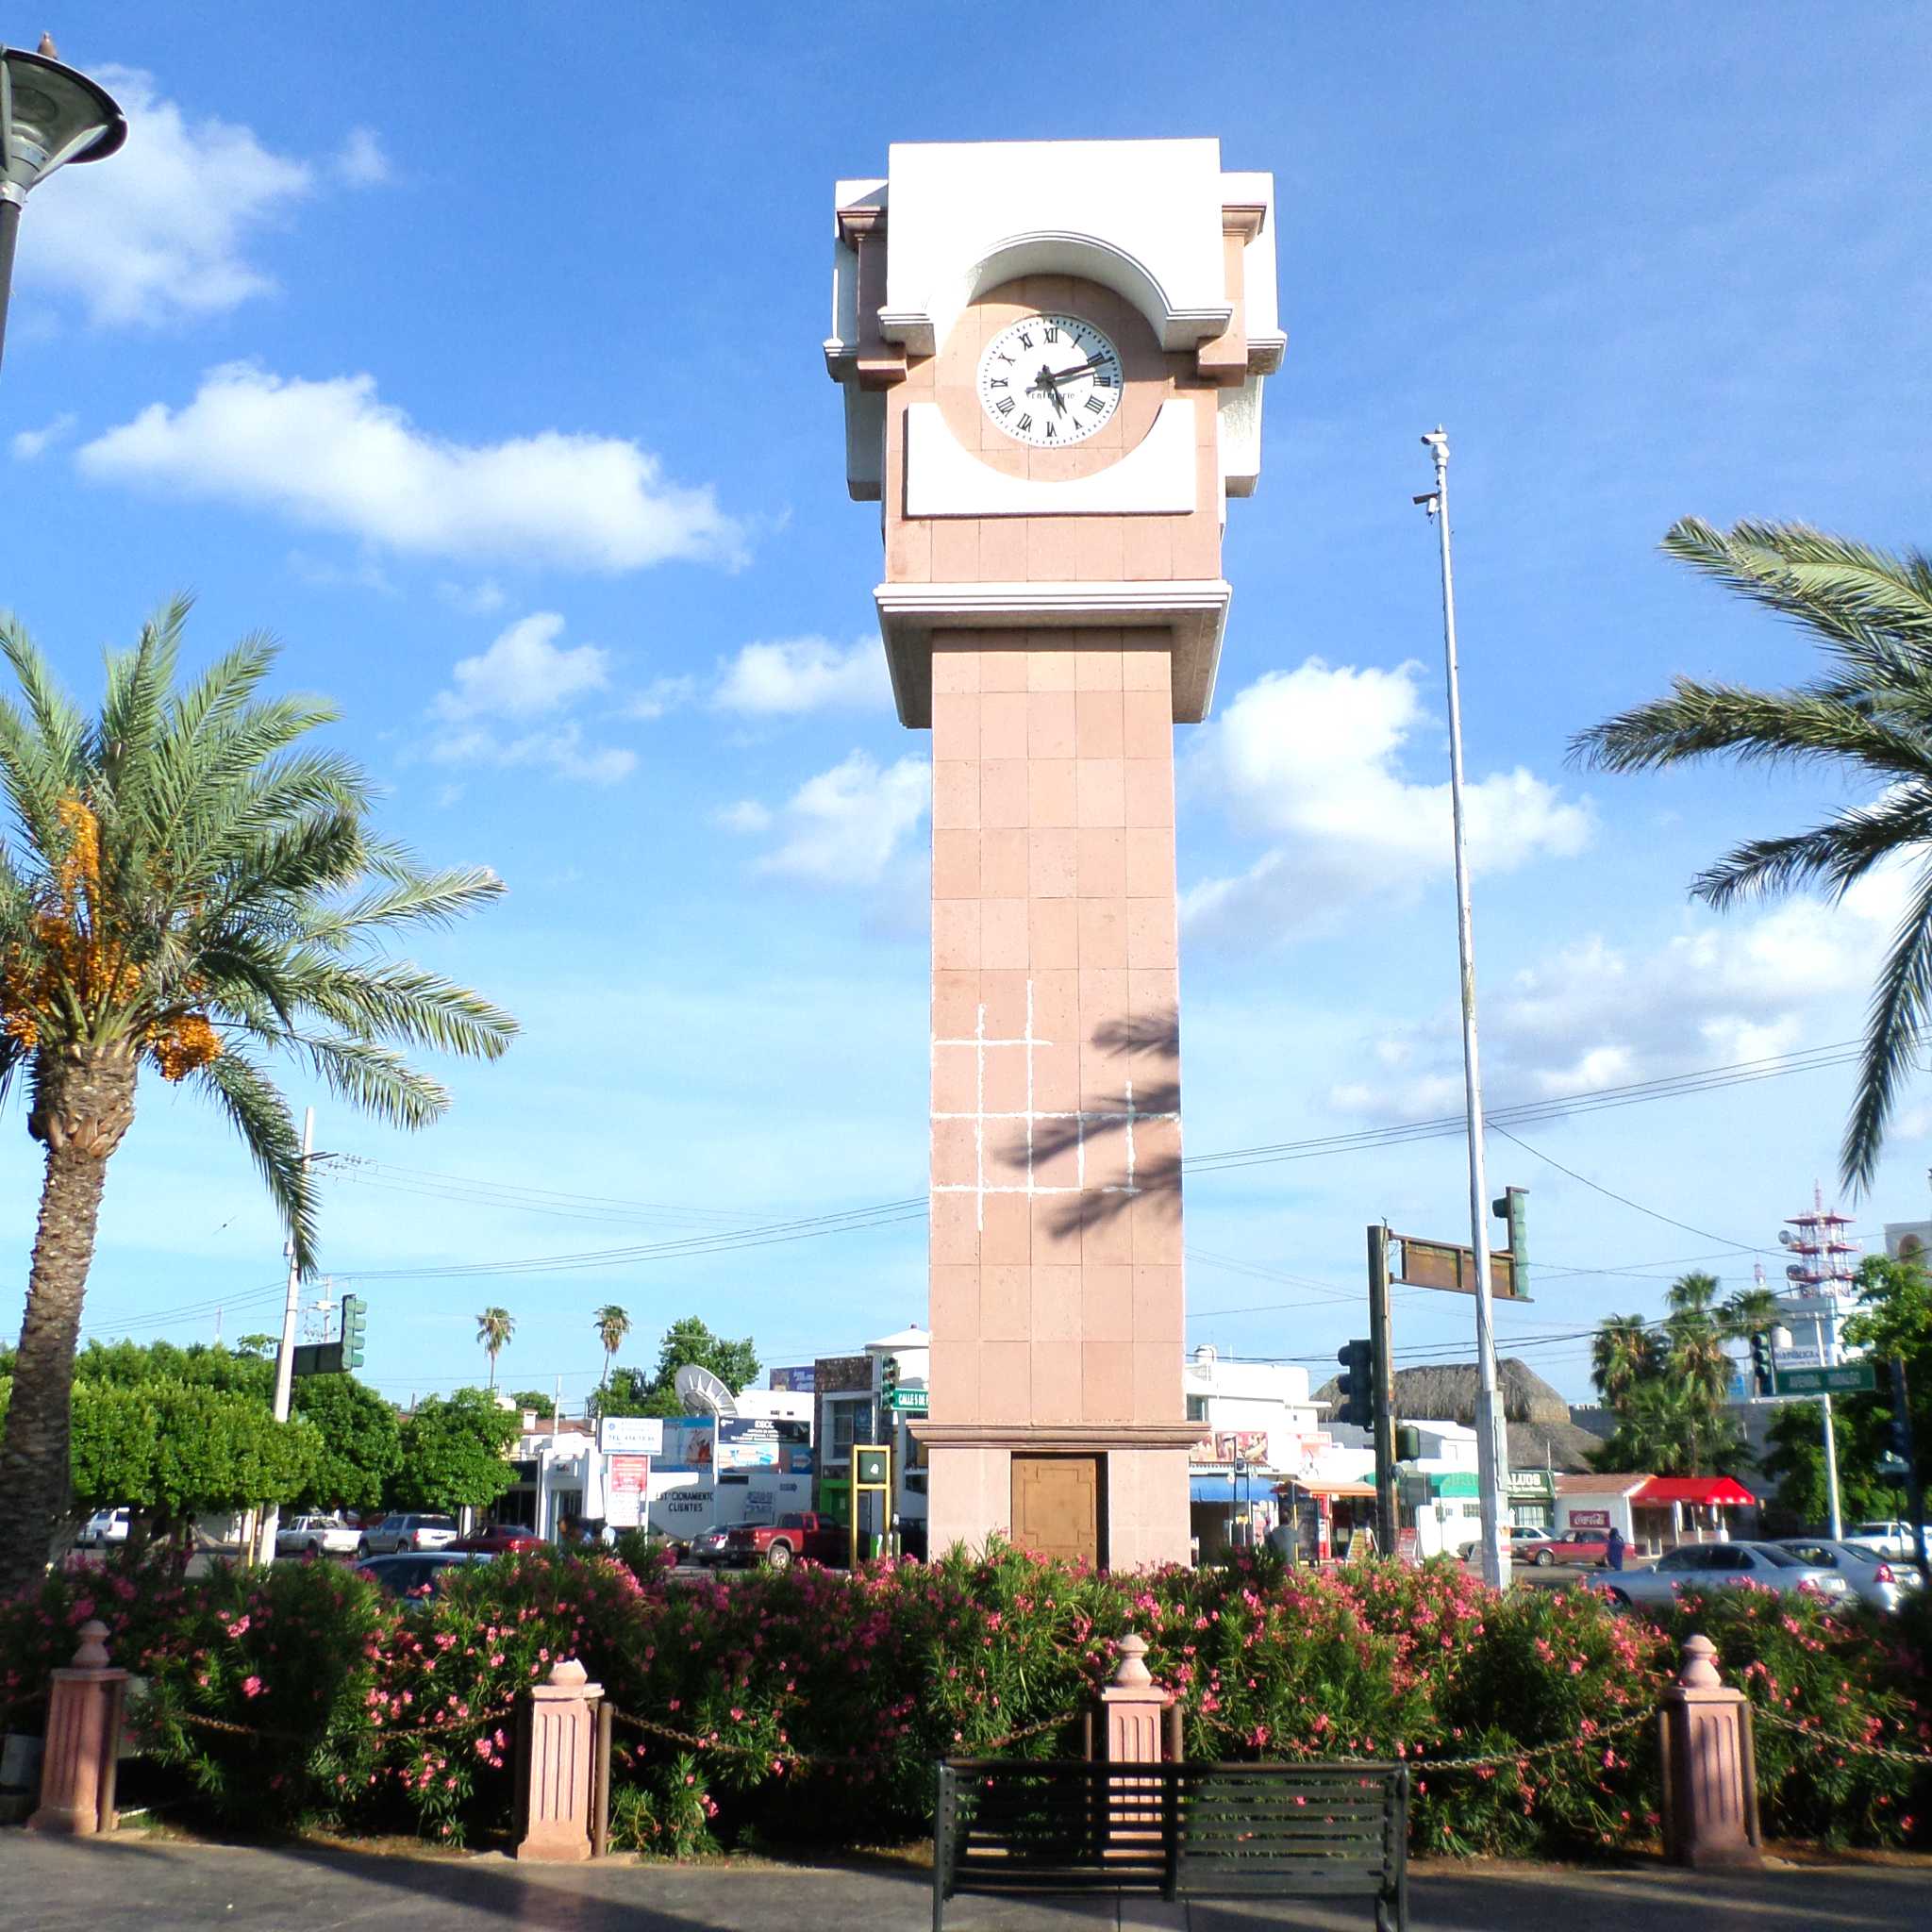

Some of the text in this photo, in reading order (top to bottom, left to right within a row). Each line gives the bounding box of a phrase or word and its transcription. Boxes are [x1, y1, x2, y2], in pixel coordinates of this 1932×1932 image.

[1018, 332, 1034, 351] XI
[1043, 327, 1059, 344] XII
[1071, 334, 1082, 349] I
[998, 352, 1016, 366] X
[991, 377, 1008, 389] IX
[1092, 376, 1111, 388] III
[996, 396, 1016, 417] VIII
[1017, 413, 1033, 433] VII
[1046, 421, 1058, 438] VI
[1073, 416, 1083, 430] V
[898, 1393, 914, 1406] CALLE
[668, 1503, 703, 1512] CLIENTES
